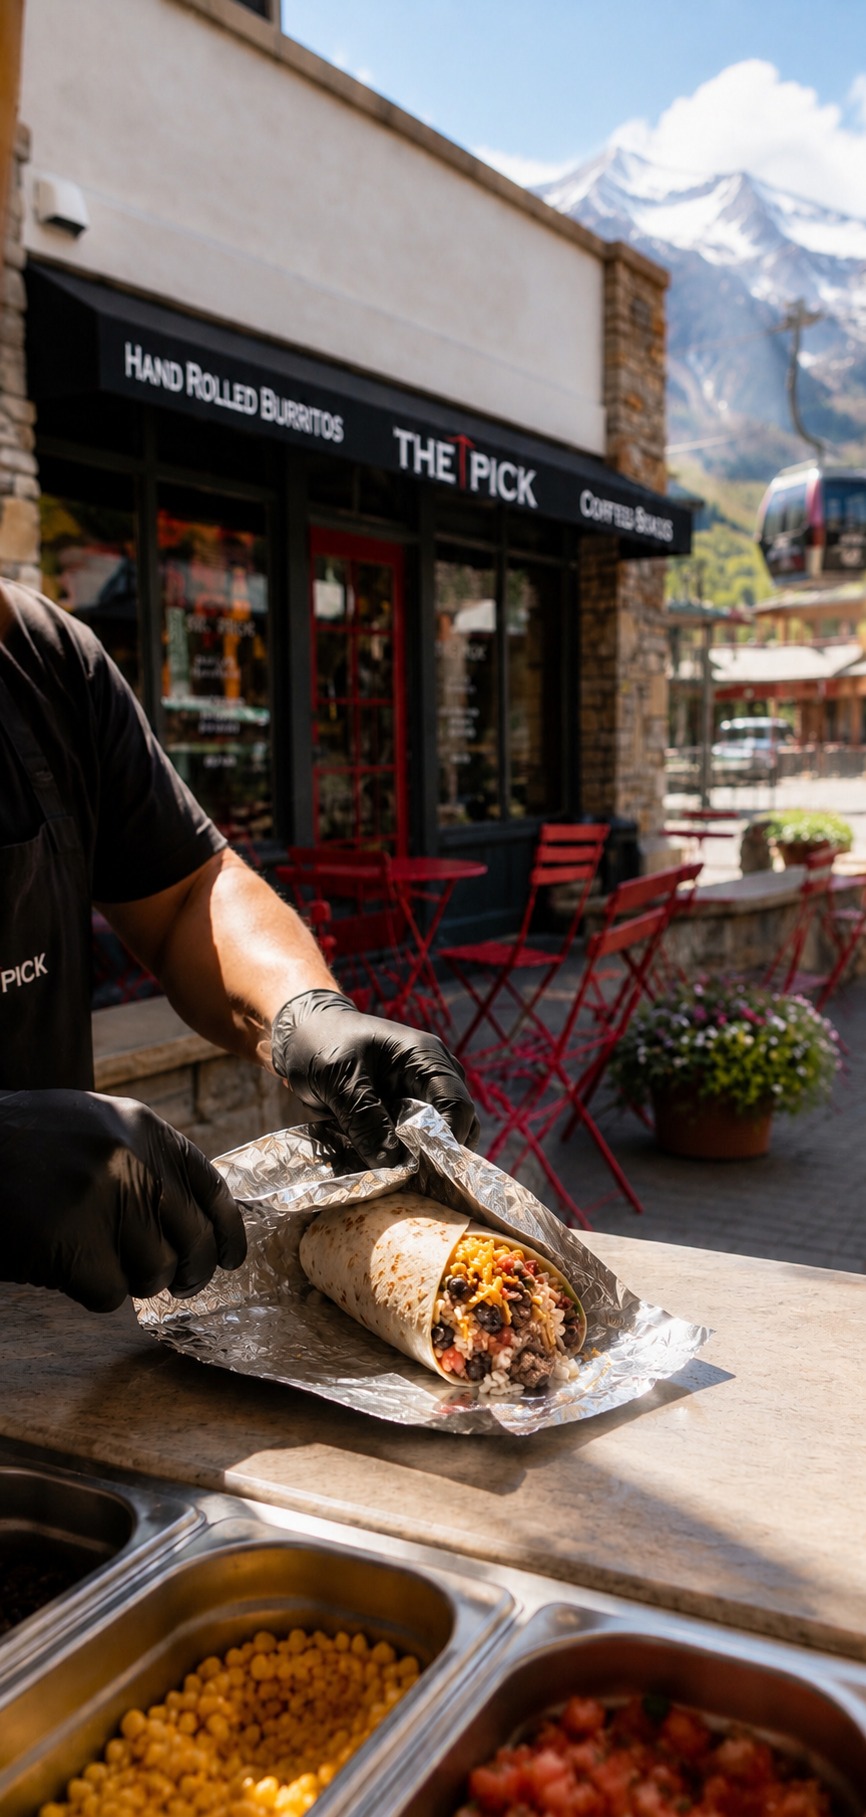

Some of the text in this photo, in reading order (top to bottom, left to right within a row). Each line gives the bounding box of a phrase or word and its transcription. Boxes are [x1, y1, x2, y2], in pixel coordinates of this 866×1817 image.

[124, 341, 345, 443] HAND ROLLED BURRITOS
[393, 426, 538, 509] THE PICK
[1, 952, 48, 993] PICK
